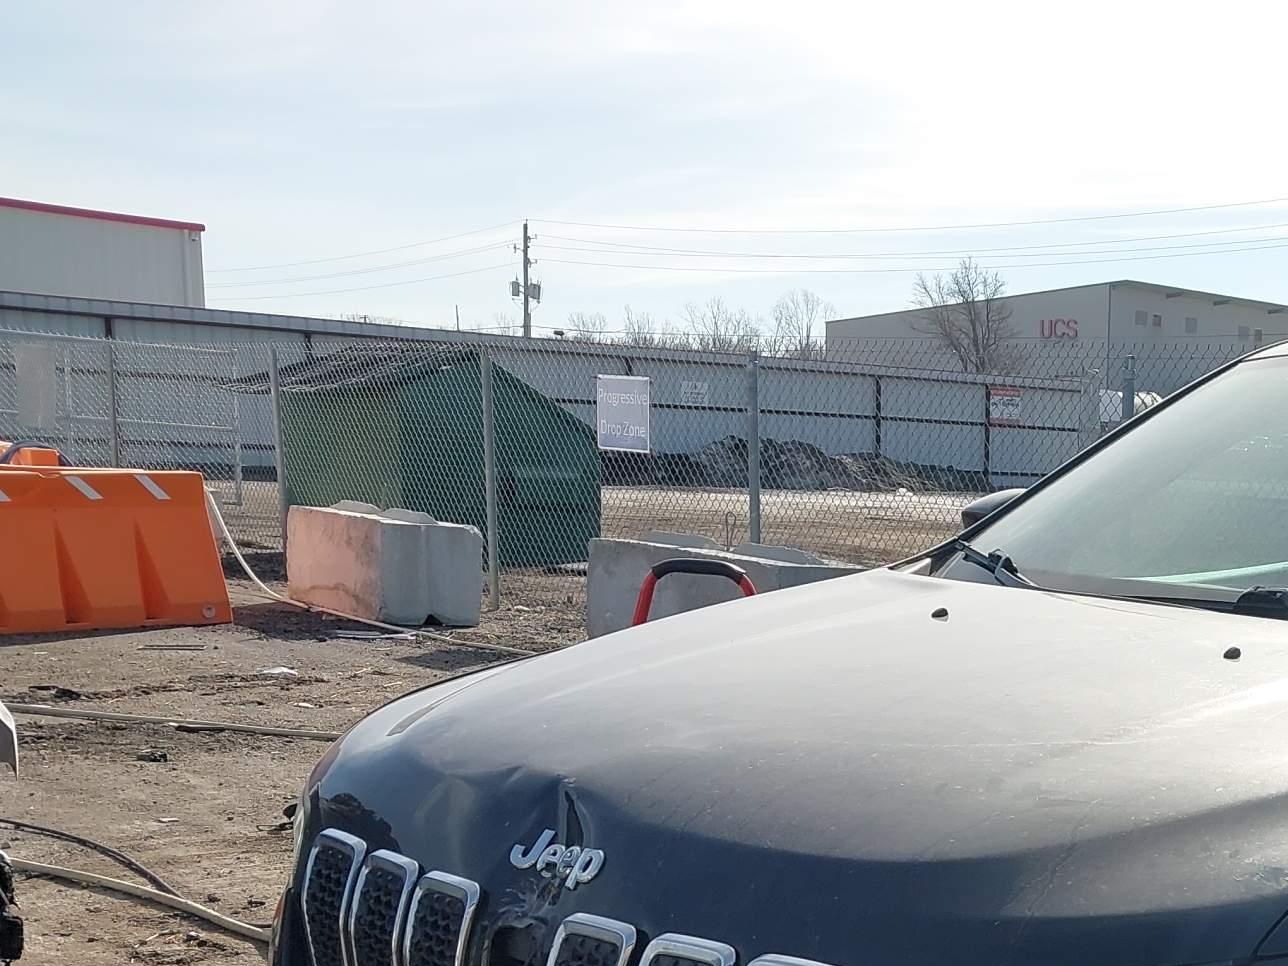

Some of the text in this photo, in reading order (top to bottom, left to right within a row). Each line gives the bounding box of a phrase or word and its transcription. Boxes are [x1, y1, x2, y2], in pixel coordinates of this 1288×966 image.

[1040, 319, 1078, 340] UCS
[598, 388, 648, 407] Progressive
[600, 419, 646, 438] Drop Zone
[509, 828, 606, 891] Jeep
